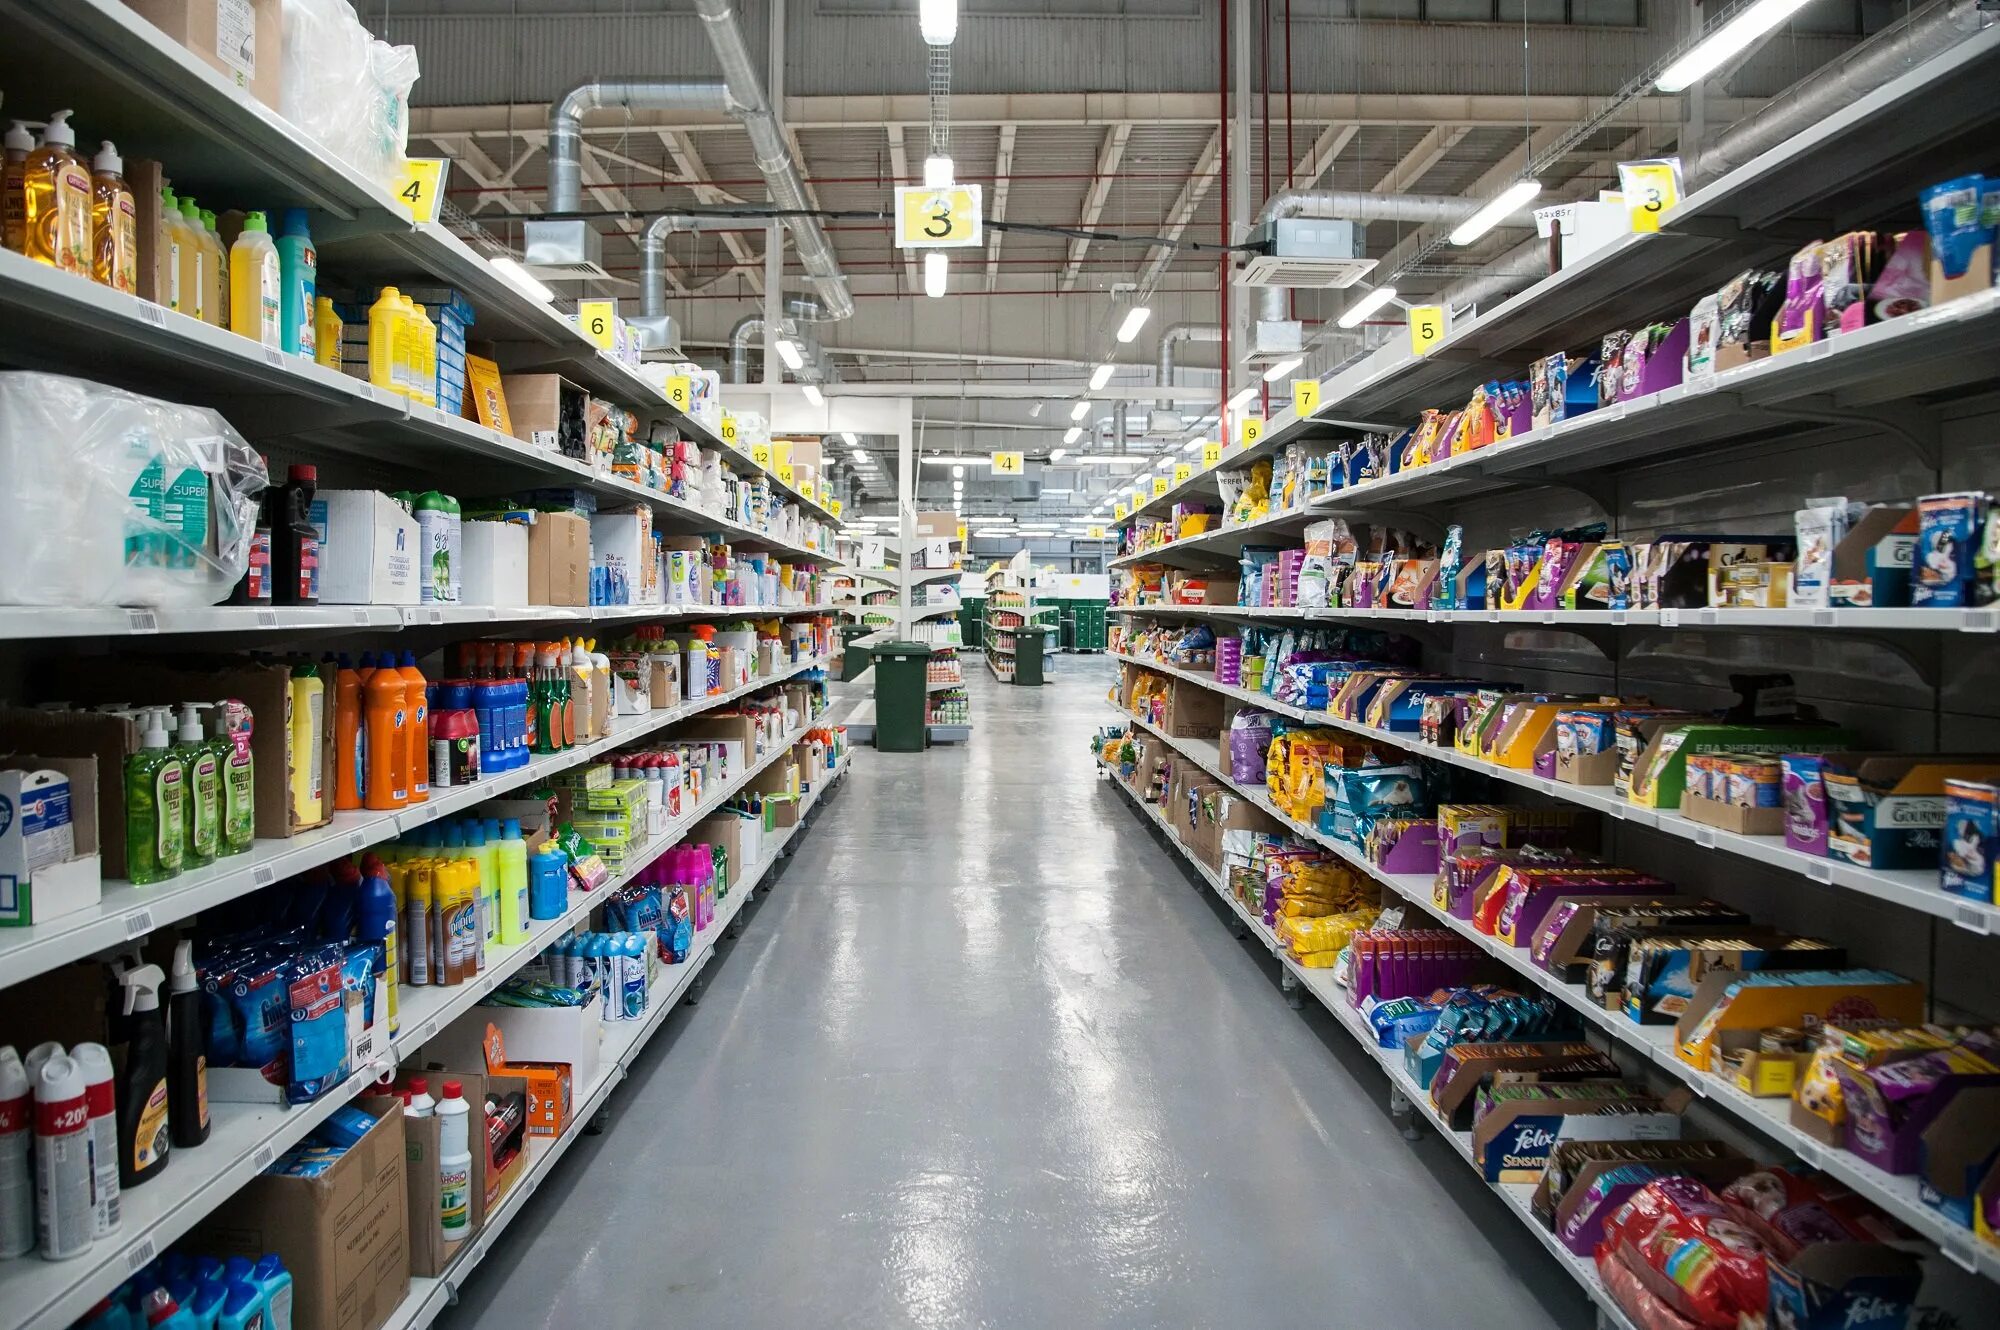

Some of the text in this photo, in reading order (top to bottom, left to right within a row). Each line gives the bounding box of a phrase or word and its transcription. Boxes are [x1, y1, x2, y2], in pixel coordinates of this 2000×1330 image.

[402, 180, 421, 203] 4
[1644, 188, 1662, 212] 3
[923, 199, 952, 237] 3
[591, 318, 604, 335] 6
[1421, 322, 1434, 339] 5
[672, 388, 683, 402] 8
[1302, 392, 1311, 405] 7
[721, 426, 735, 438] 10
[1248, 427, 1257, 439] 9
[754, 452, 768, 462] 12
[1206, 450, 1219, 461] 11
[1002, 456, 1013, 471] 4
[780, 472, 791, 481] 14
[1219, 477, 1242, 486] PERFE
[140, 477, 164, 490] SUPE
[1155, 484, 1166, 492] 15
[801, 487, 812, 495] 16
[1094, 528, 1099, 537] 1
[871, 543, 879, 554] 7
[934, 544, 942, 555] 4
[605, 553, 615, 561] 36
[1407, 692, 1426, 709] fel
[230, 769, 252, 783] GREEN
[199, 778, 214, 794] GREE
[236, 782, 249, 792] TEA
[163, 787, 180, 803] GREE
[204, 791, 214, 801] TEA
[169, 801, 180, 812] TEA
[638, 906, 662, 926] finish
[1513, 1128, 1555, 1154] felix
[1502, 1154, 1549, 1168] SENSATI
[1844, 1298, 1897, 1330] felix
